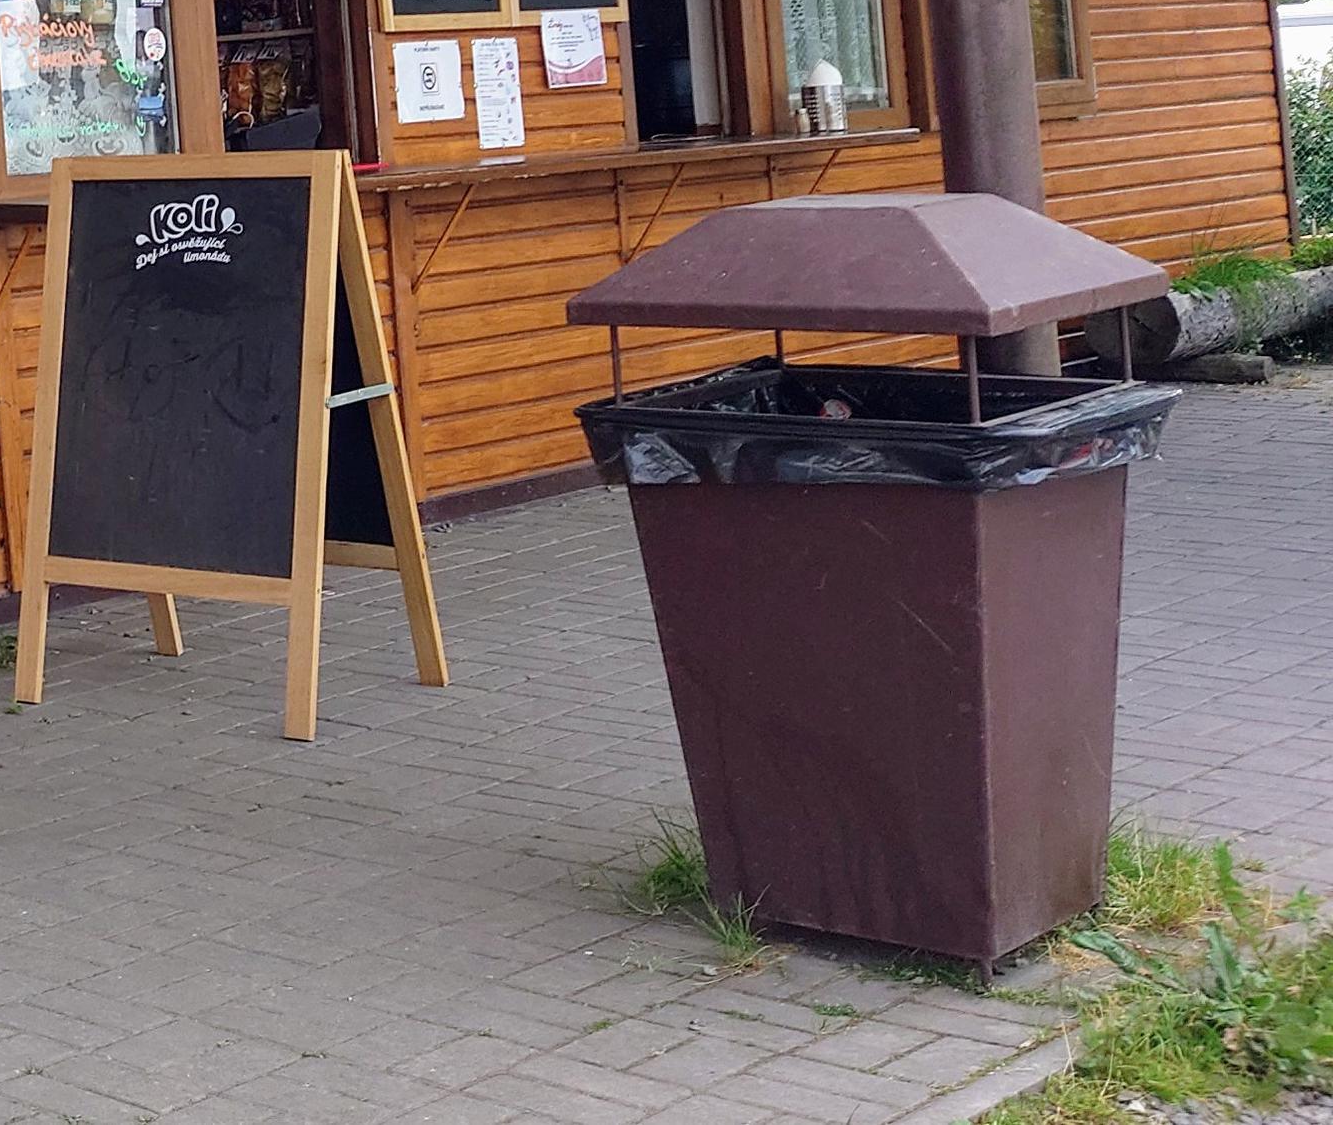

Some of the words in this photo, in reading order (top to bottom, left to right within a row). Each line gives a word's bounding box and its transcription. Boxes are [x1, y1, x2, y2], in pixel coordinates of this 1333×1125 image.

[150, 194, 220, 244] Koli
[135, 249, 159, 270] Dej
[159, 245, 170, 258] si
[183, 250, 232, 265] limonádu
